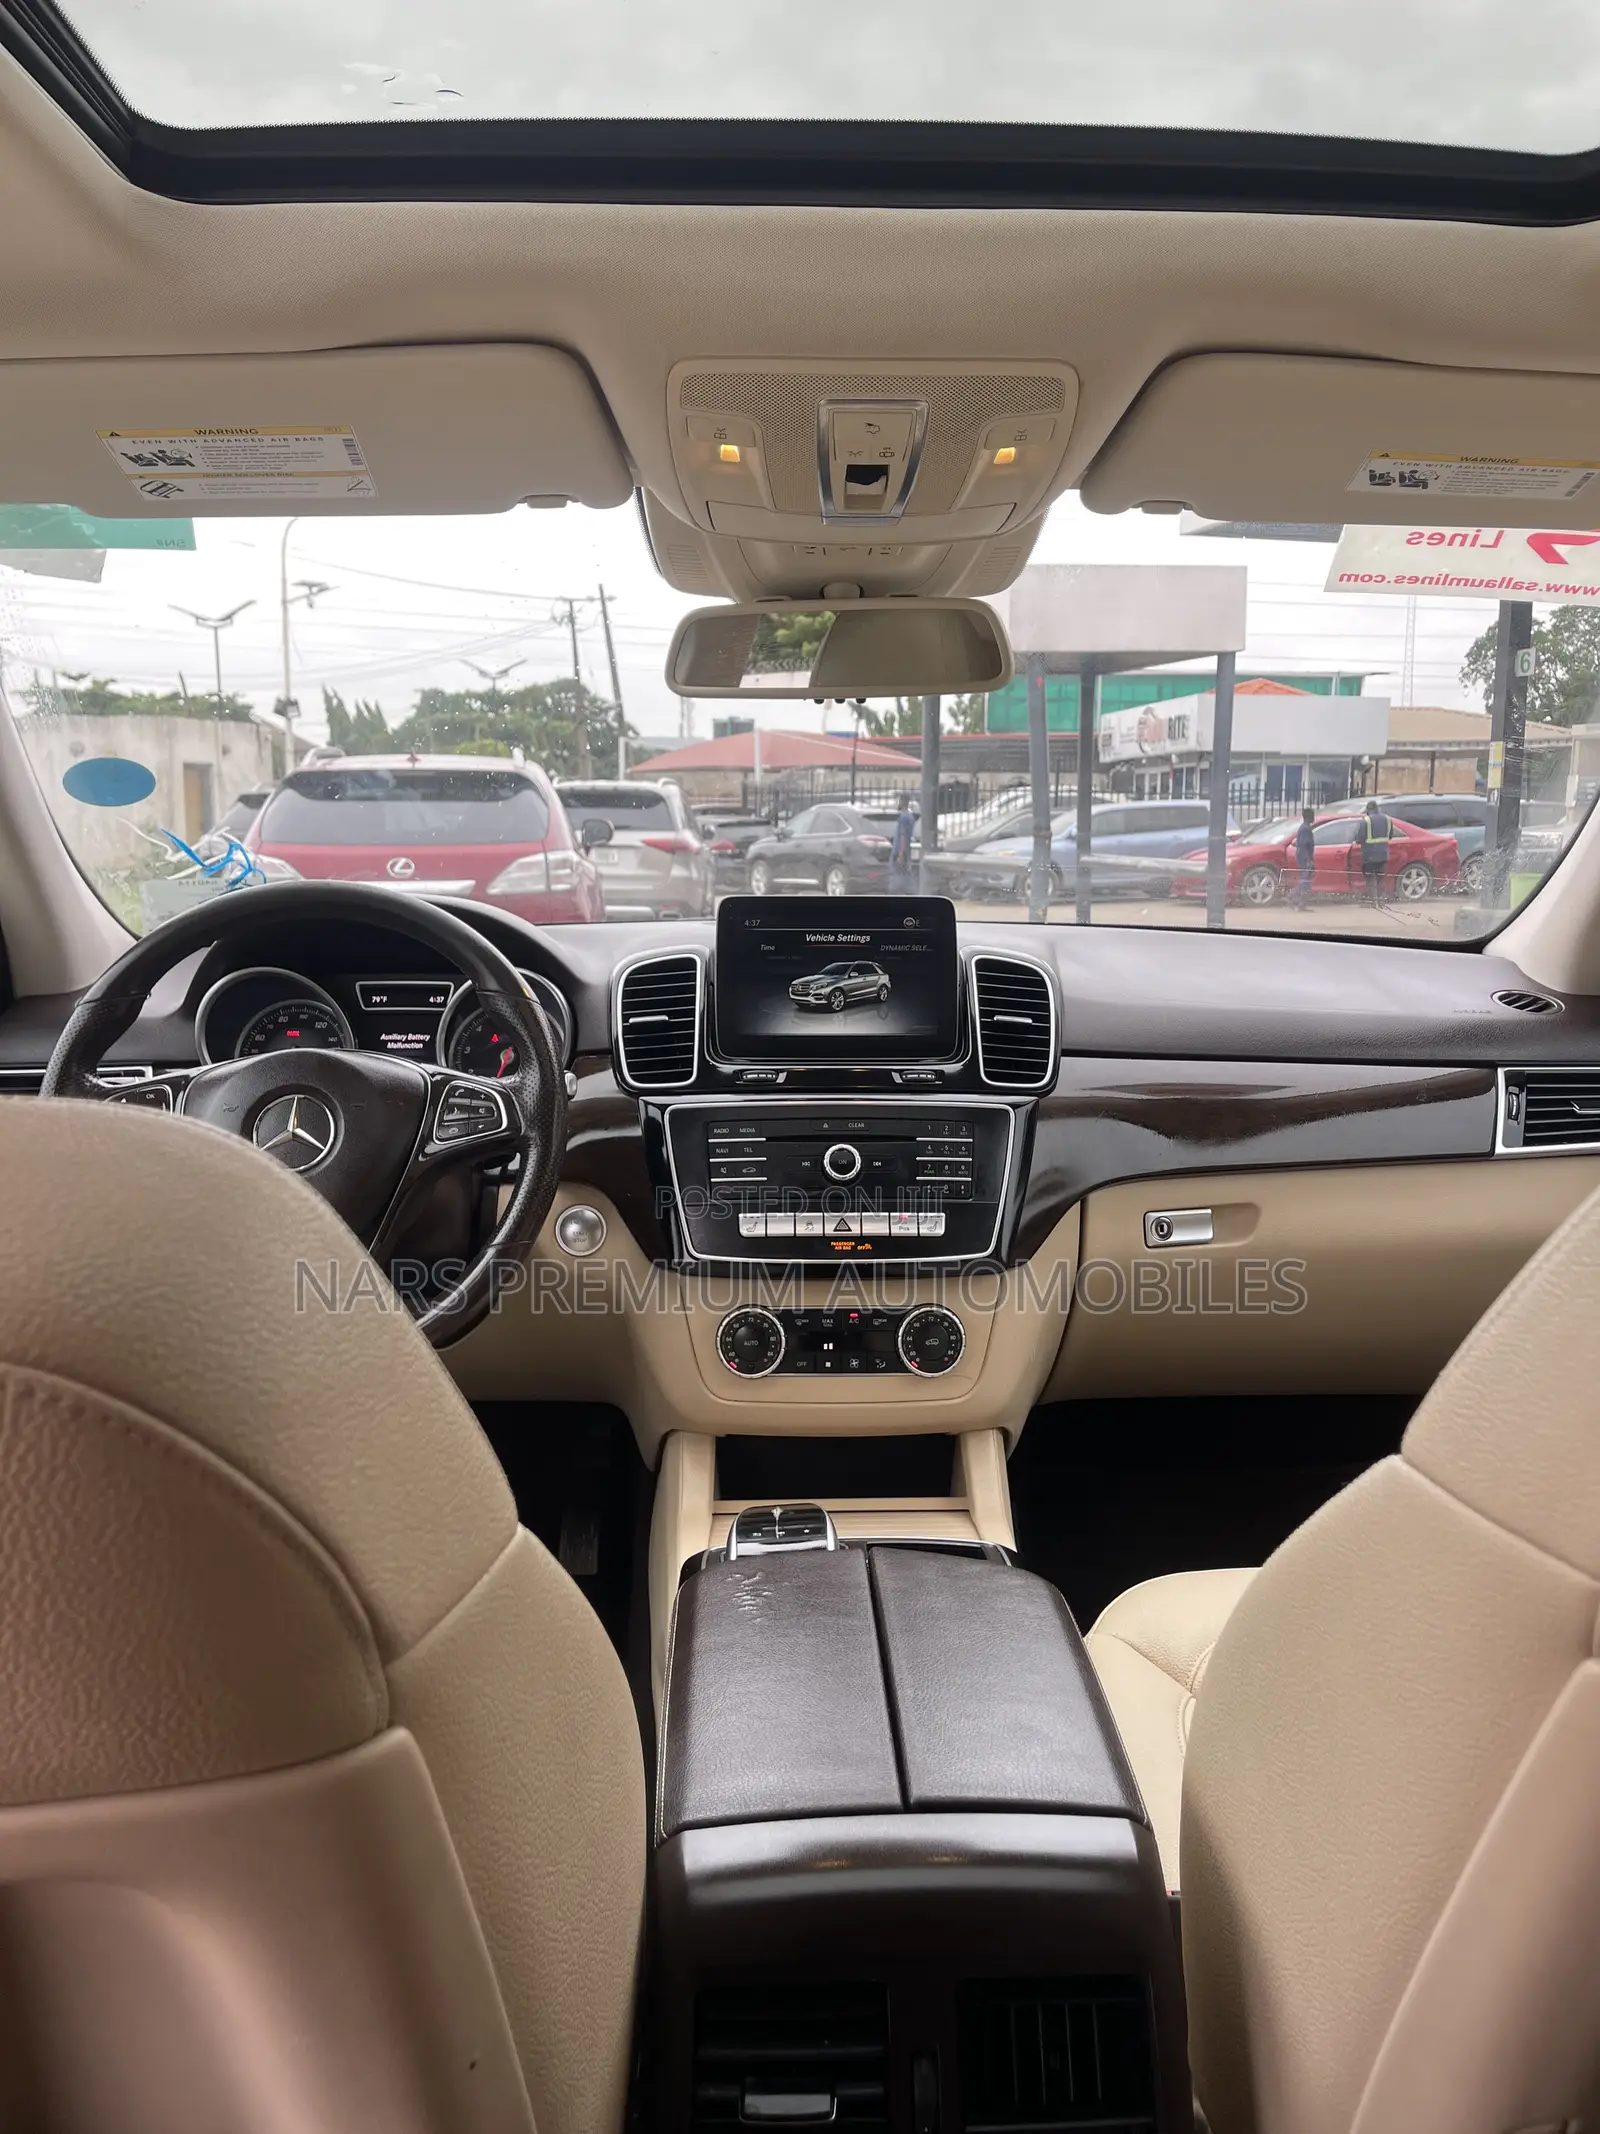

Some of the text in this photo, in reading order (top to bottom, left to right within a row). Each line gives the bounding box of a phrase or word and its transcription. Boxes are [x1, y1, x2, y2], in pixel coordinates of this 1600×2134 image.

[194, 428, 259, 436] WARNING
[1460, 456, 1520, 464] WARNING
[1519, 651, 1531, 673] 6
[744, 919, 761, 927] 4:37
[805, 933, 871, 943] Vehicle Settings
[429, 996, 445, 1004] 4:37
[314, 1021, 328, 1029] 120
[380, 1033, 431, 1042] Auxiliary Battery
